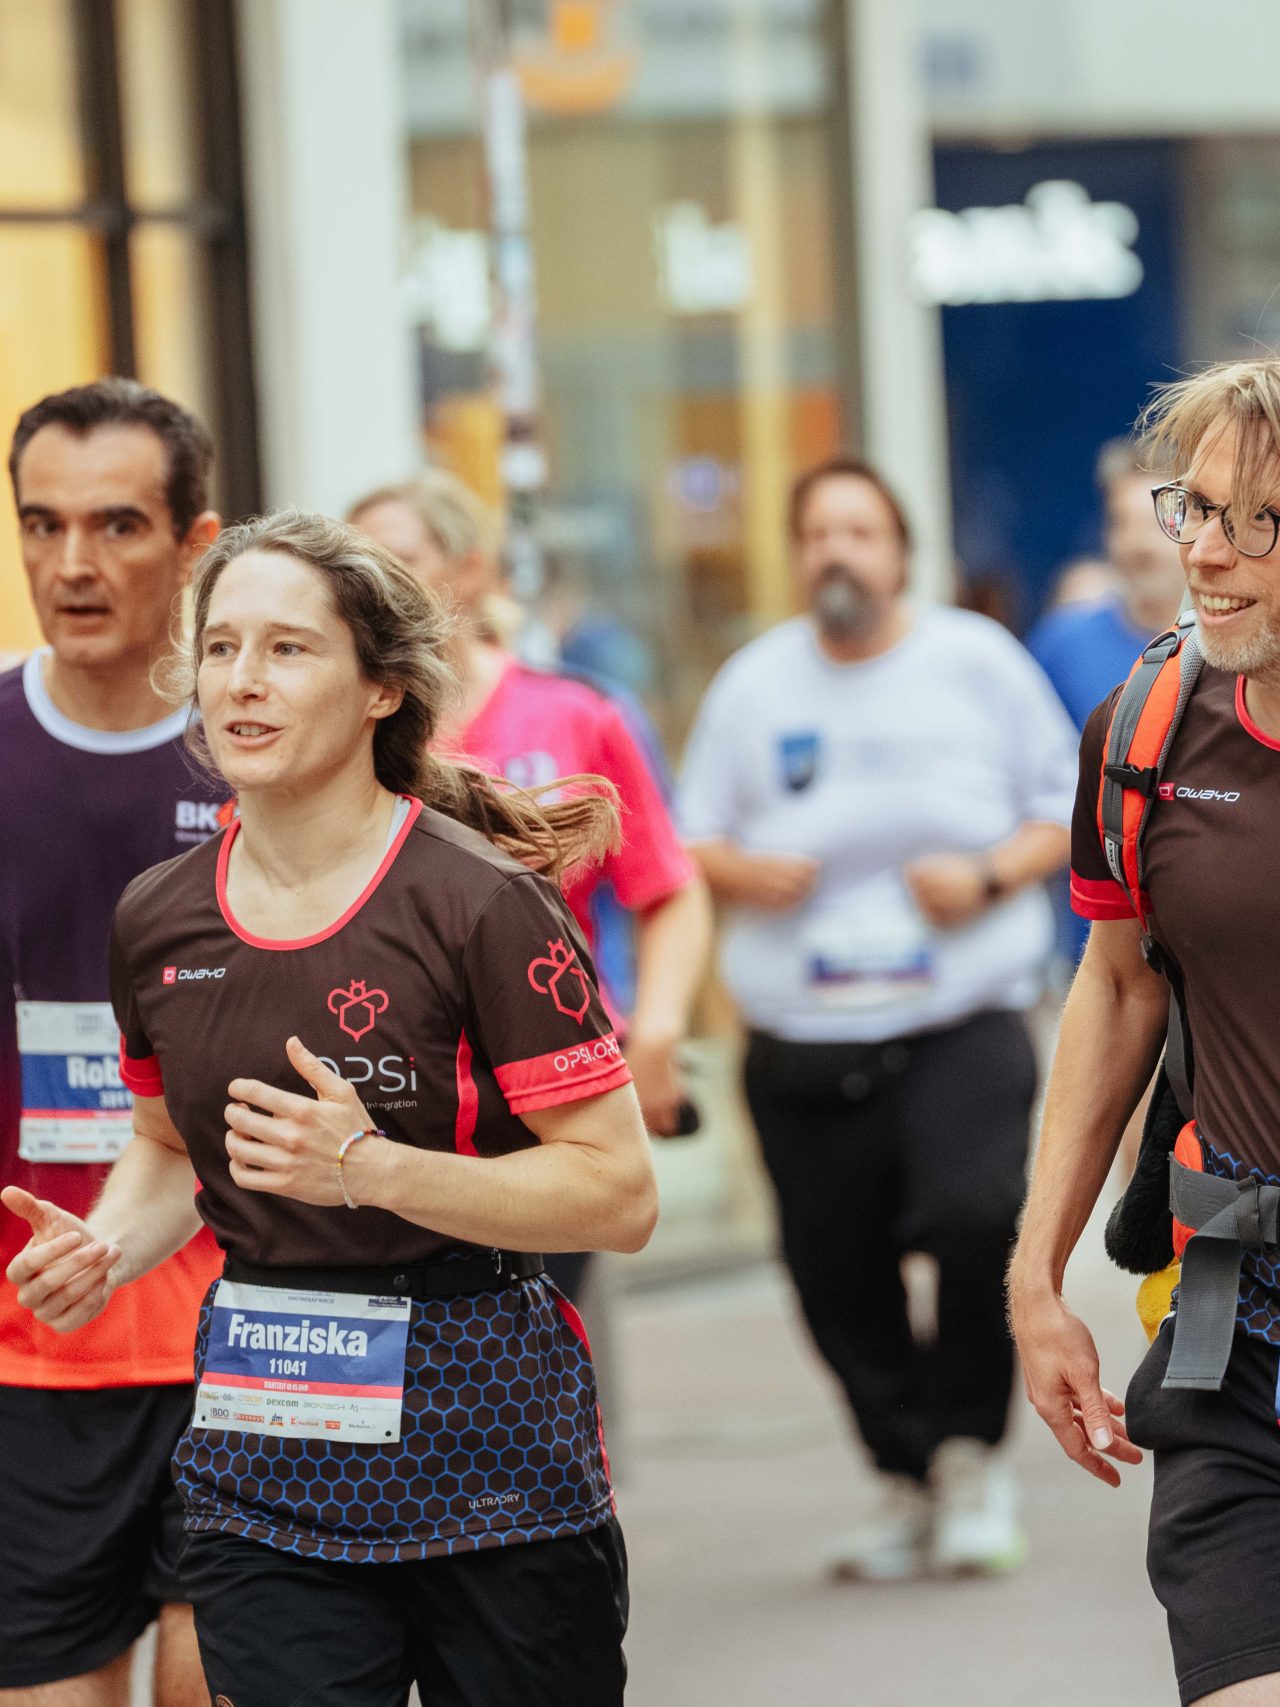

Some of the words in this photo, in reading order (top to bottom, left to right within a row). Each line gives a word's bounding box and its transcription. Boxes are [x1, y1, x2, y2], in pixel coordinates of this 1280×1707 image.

[66, 1055, 123, 1089] Rob
[366, 1099, 418, 1112] Integration
[227, 1313, 369, 1357] Franziska
[269, 1357, 307, 1376] 11041
[212, 1407, 230, 1418] BDO
[468, 1493, 520, 1510] ULTRADRY
